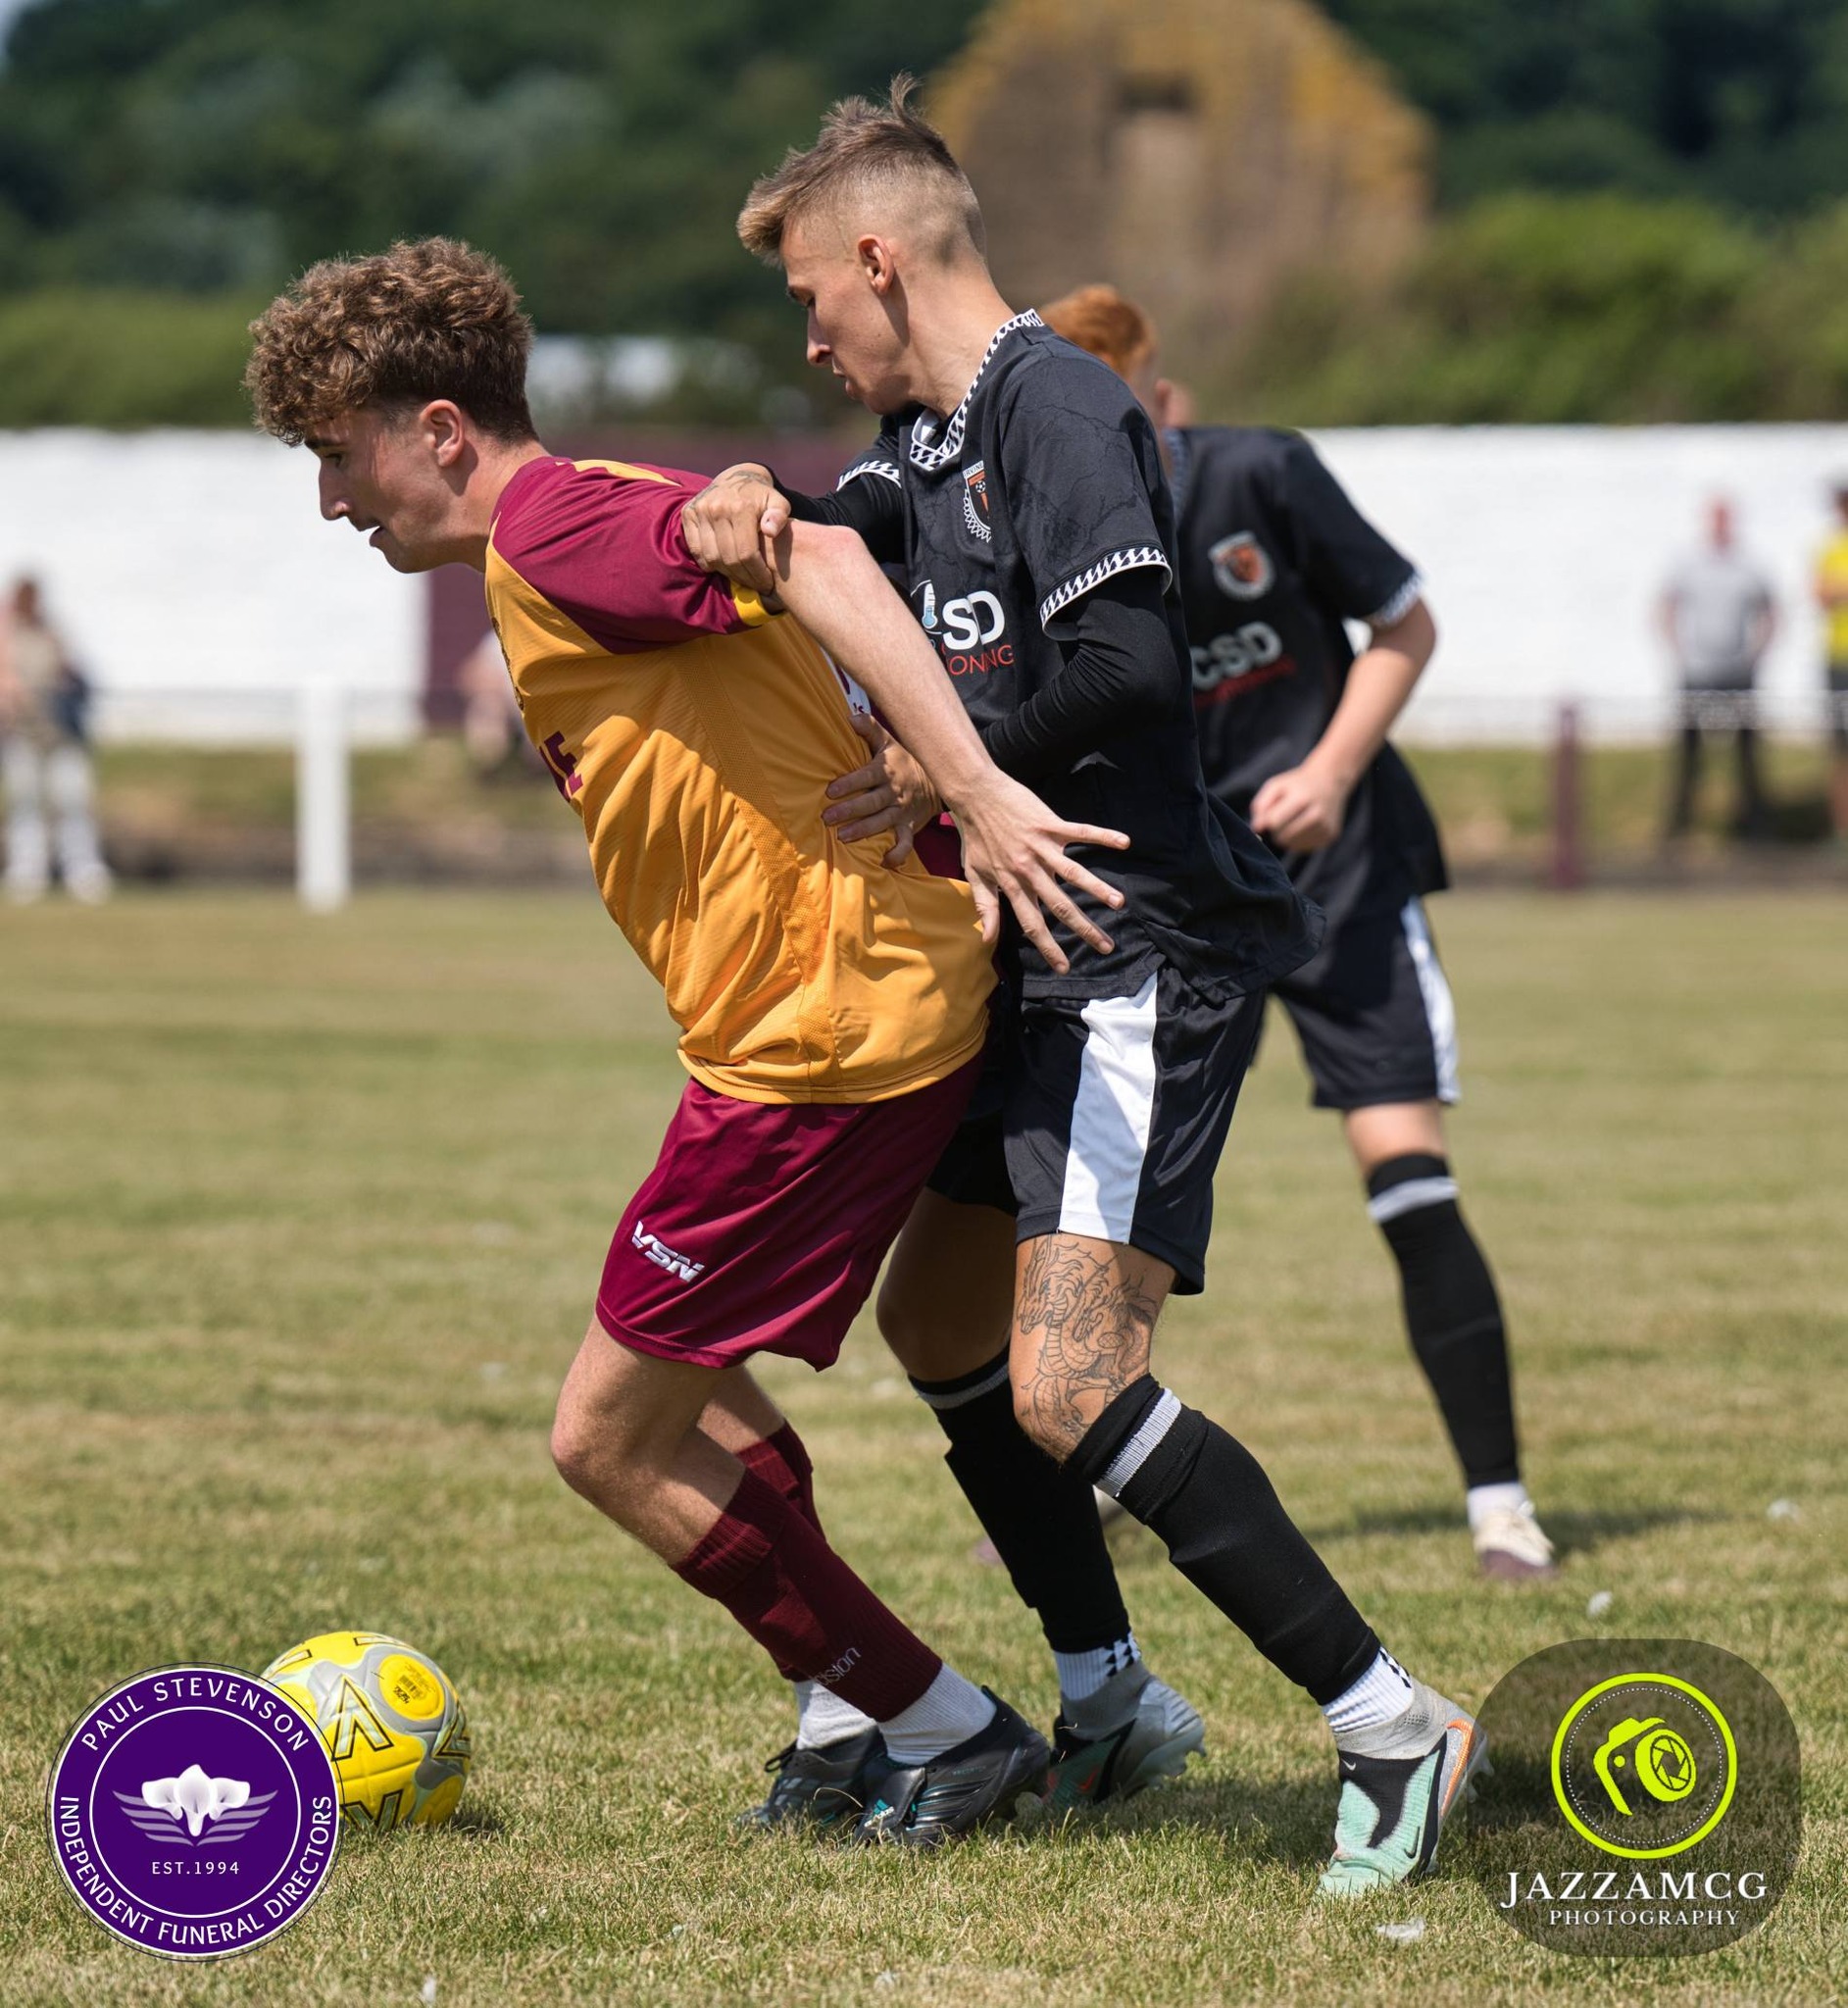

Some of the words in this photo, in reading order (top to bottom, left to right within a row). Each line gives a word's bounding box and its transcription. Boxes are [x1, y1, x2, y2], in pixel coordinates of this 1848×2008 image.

[918, 581, 1005, 651] SD
[1190, 622, 1281, 690] CSD
[631, 1220, 705, 1282] VSN
